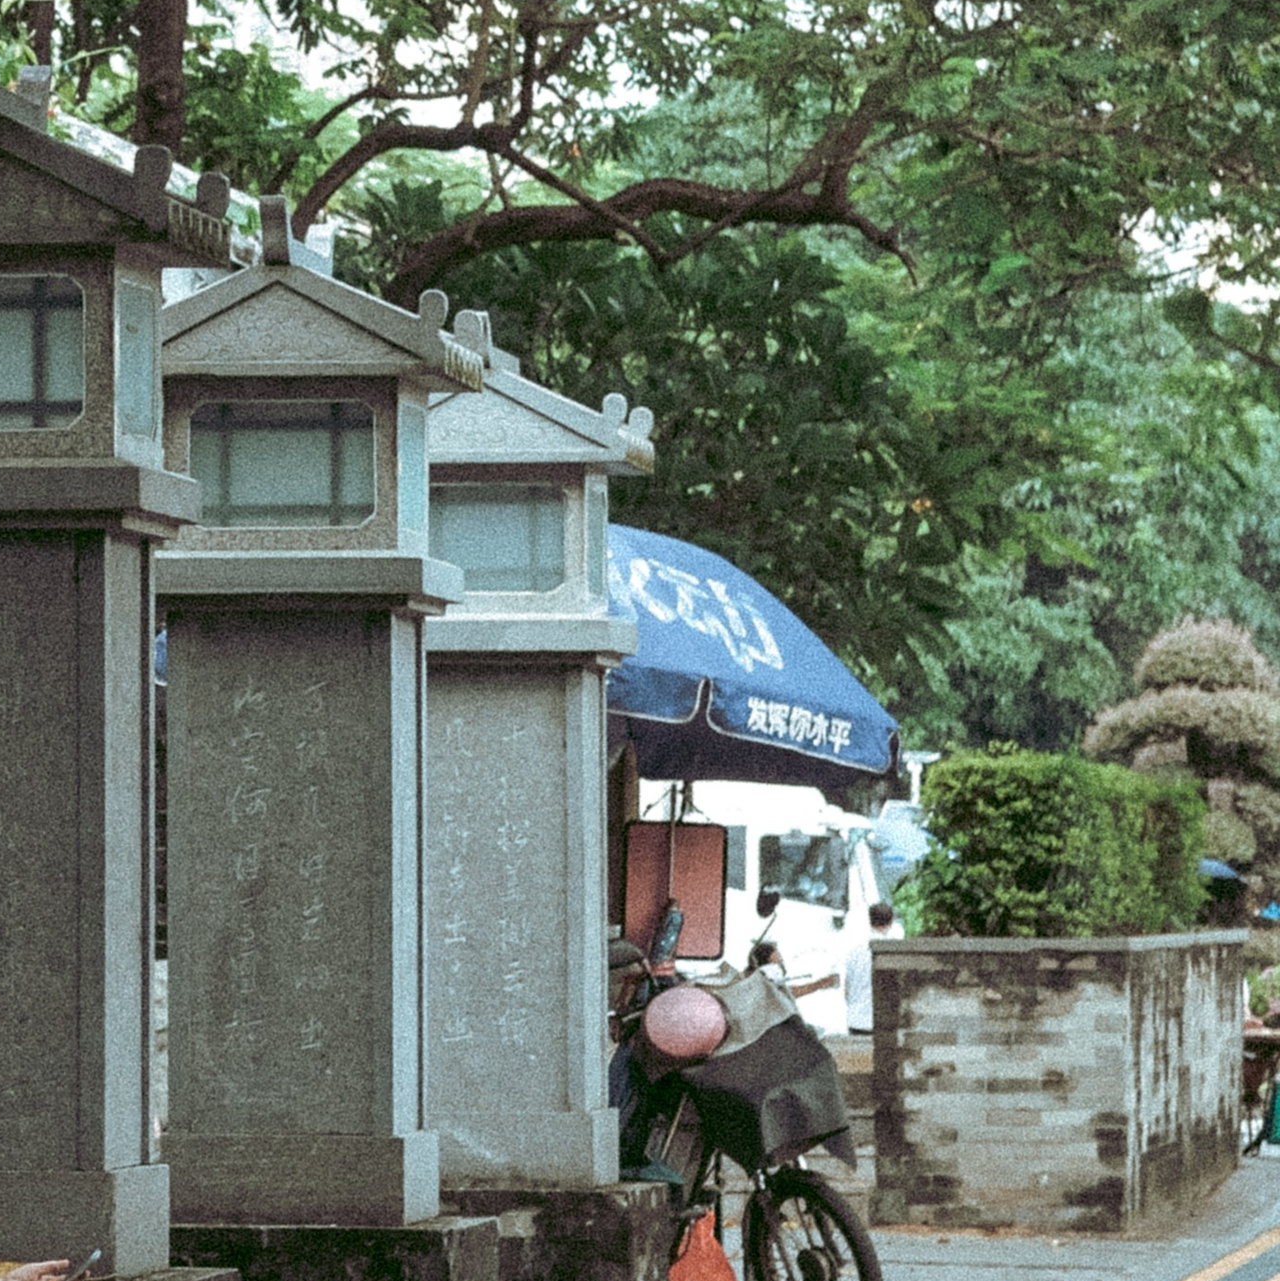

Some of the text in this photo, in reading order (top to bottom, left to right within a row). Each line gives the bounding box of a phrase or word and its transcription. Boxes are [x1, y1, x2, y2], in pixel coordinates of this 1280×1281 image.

[747, 696, 852, 754] 发挥你水平
